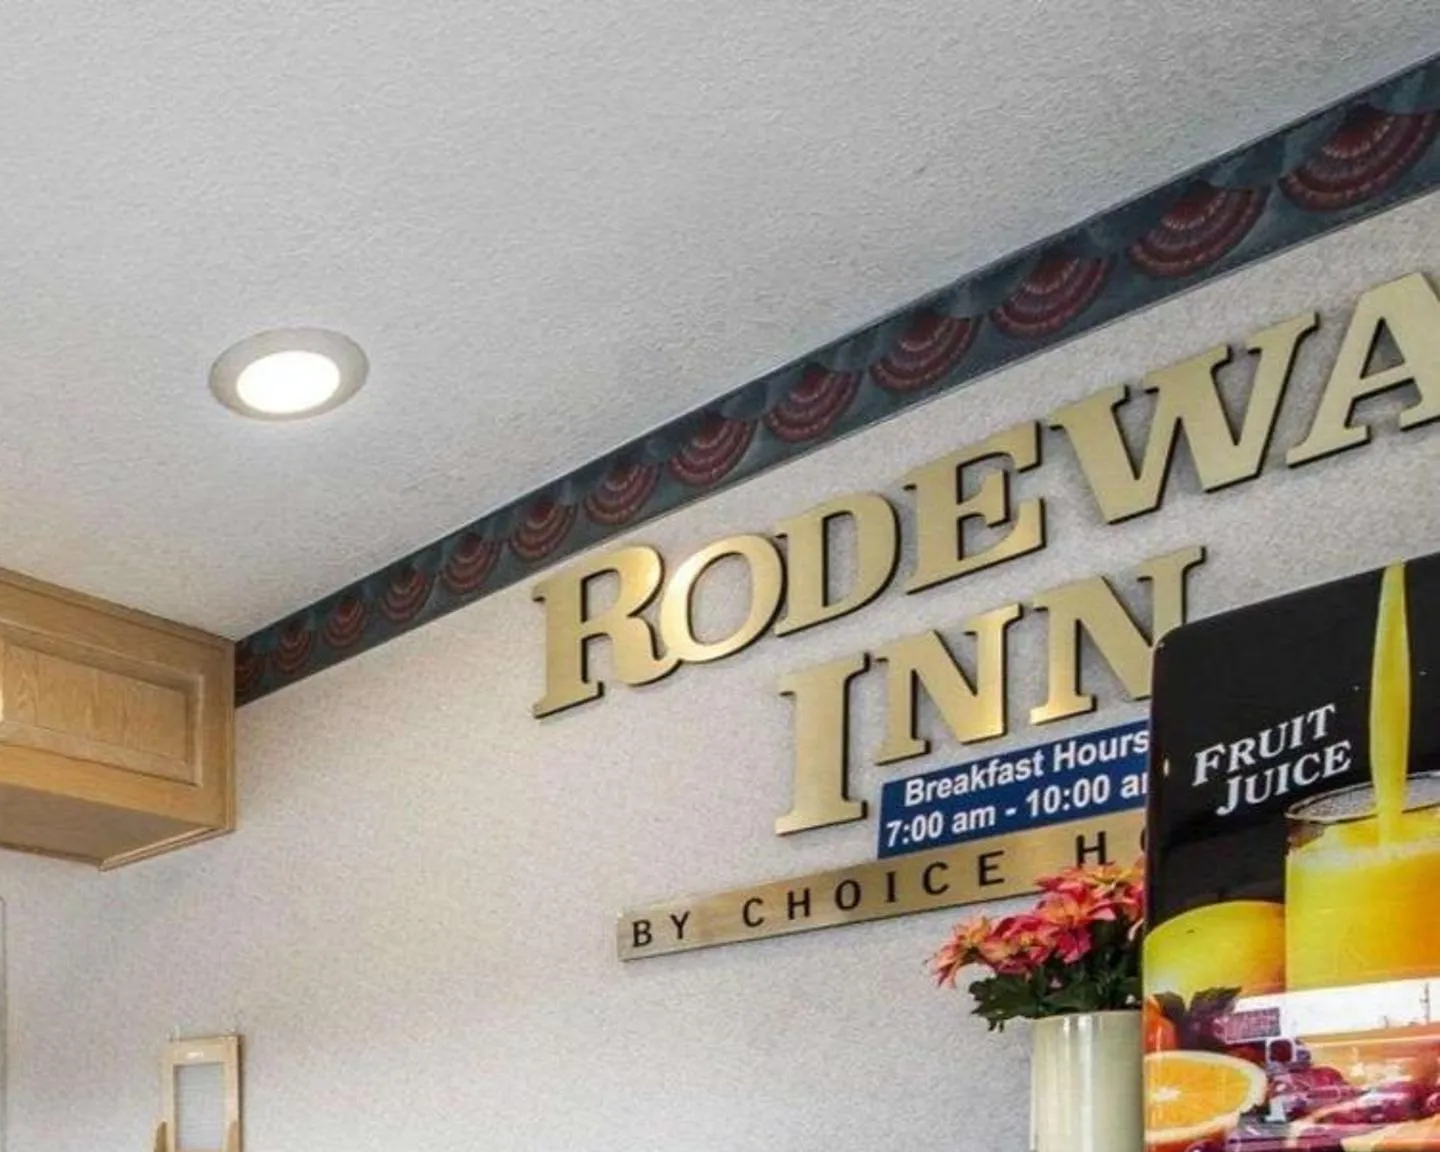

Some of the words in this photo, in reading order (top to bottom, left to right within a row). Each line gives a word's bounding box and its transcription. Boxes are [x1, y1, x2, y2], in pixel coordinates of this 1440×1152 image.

[533, 272, 1440, 717] RODEWA
[775, 545, 1205, 836] INN
[905, 751, 1044, 807] Breakfast
[1054, 729, 1148, 775] Hours
[1192, 704, 1335, 787] FRUIT
[1216, 740, 1352, 816] JUICE
[886, 813, 944, 847] 7:00
[952, 807, 996, 834] am
[1026, 775, 1111, 818] 10:00
[632, 911, 691, 948] BY
[744, 850, 1006, 928] CHOICE
